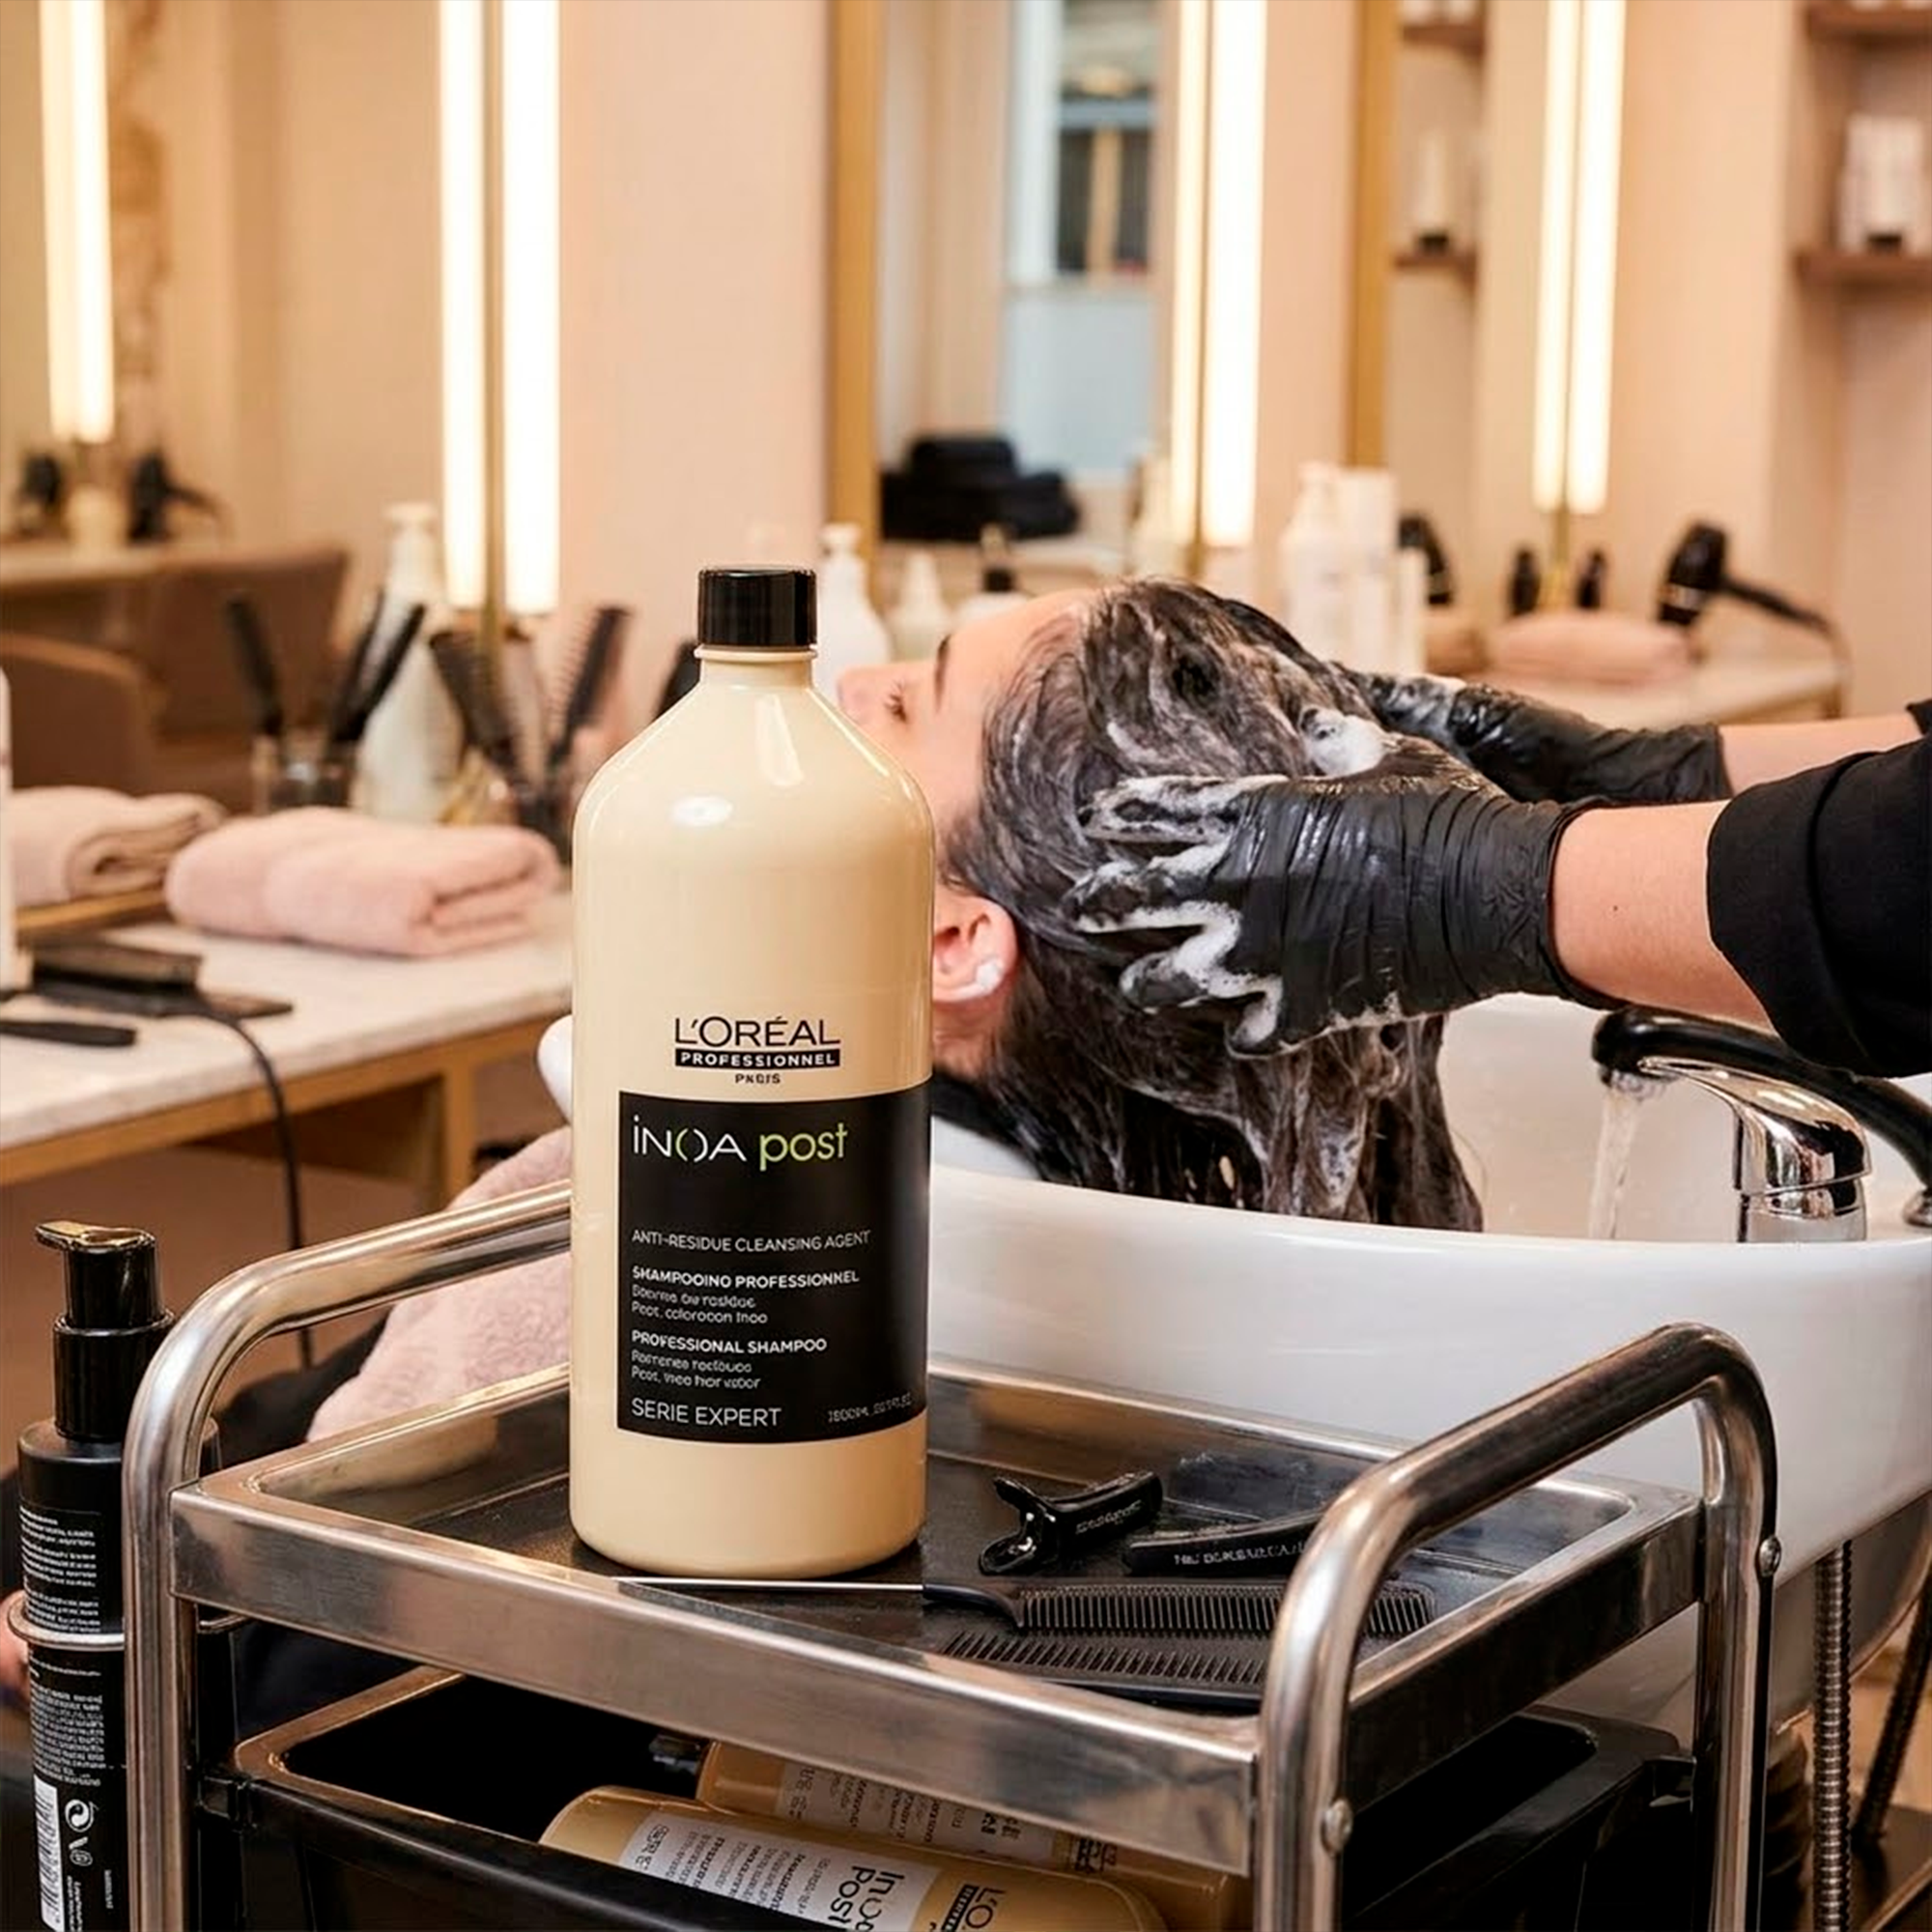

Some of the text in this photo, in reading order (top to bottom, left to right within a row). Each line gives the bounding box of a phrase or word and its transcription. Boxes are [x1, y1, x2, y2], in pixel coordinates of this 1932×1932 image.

[675, 1015, 840, 1047] L'ORÉAL
[680, 1051, 837, 1067] PROFESSIONNEL
[759, 1122, 848, 1172] post
[631, 1229, 871, 1253] ANTI-RESIDUE CLEANSING AGENT
[734, 1269, 860, 1290] PROFESSIONNEL
[632, 1329, 827, 1354] PROFESSIONAL SHAMPOO
[631, 1397, 781, 1427] SERIE EXPERT
